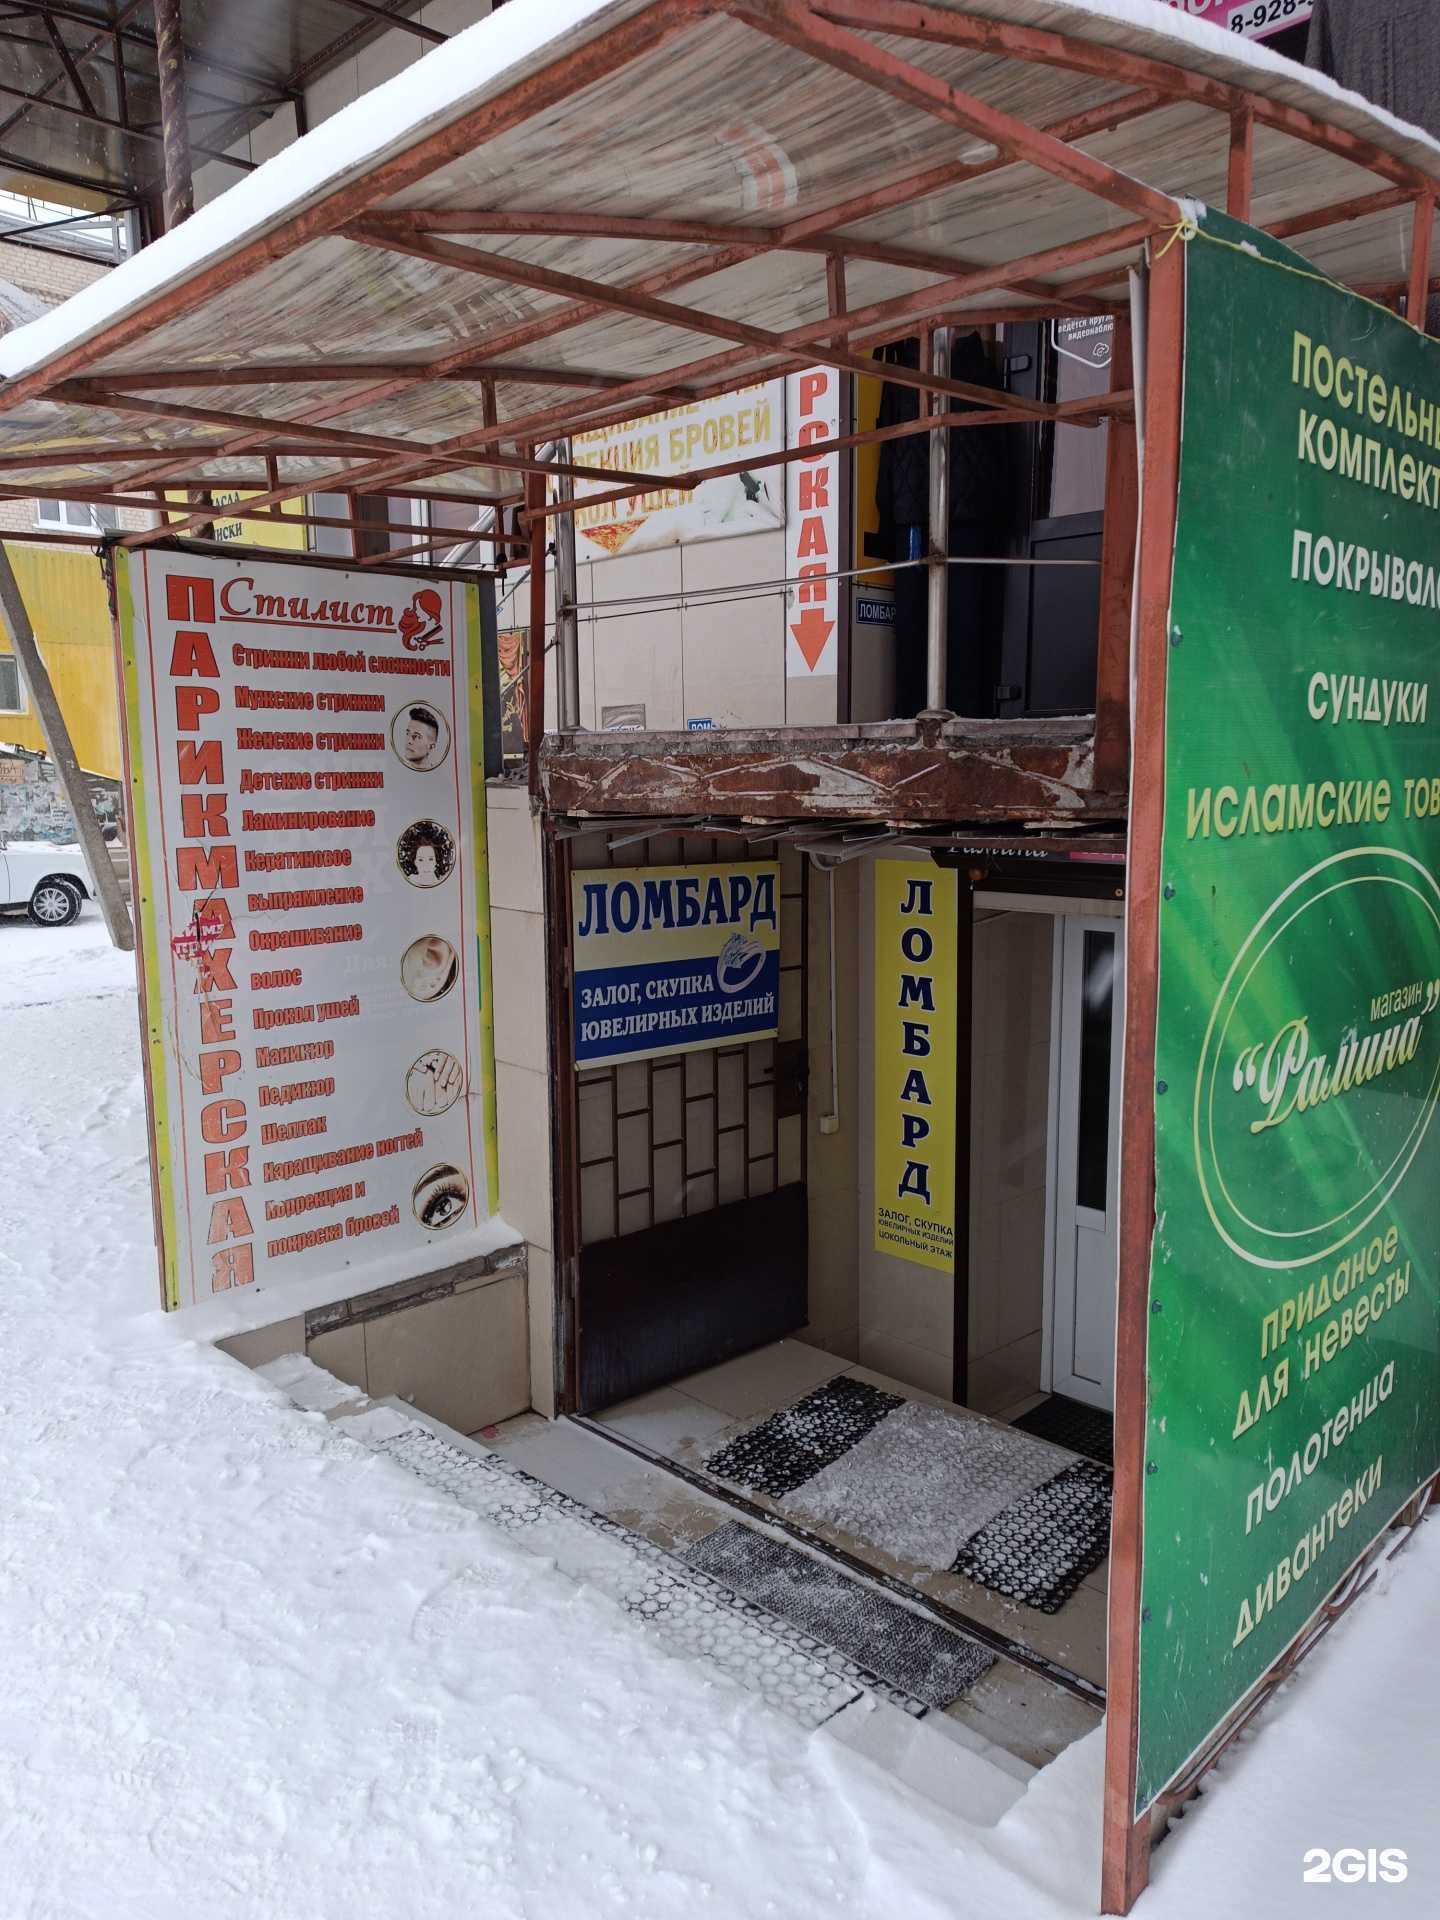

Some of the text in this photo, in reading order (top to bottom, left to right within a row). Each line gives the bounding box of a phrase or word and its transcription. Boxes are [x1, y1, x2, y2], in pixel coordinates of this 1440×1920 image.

[1231, 0, 1313, 33] 8-928-
[669, 399, 771, 464] БРОВЕЙ
[219, 577, 394, 626] Стилист
[232, 643, 451, 677] Стрижки любой сложности
[234, 685, 385, 713] Мужские стрижки
[236, 727, 385, 752] Женские стрижки
[240, 769, 384, 794] Детские стрижки
[242, 809, 375, 831] Ламинирование
[244, 848, 352, 872] Кератиновое
[579, 874, 776, 936] ЛОМБАРД
[165, 574, 255, 1294] ПАРИКМАХЕРСКАЯ
[249, 924, 362, 951] Окрашивание
[250, 968, 303, 991] волос
[581, 974, 714, 1009] ЗАЛОГ, СКУПКА
[252, 995, 360, 1030] Прокол ушей
[581, 992, 775, 1042] ЮВЕЛИРНЫХ ИЗДЕЛИЙ
[1371, 981, 1423, 1022] магазин
[255, 1039, 335, 1068] Маникюр
[898, 879, 935, 1206] ЛОМБАРД
[258, 1077, 336, 1107] Педикюр
[261, 1115, 327, 1145] Шеллак
[263, 1127, 424, 1183] Наращивание ногтей
[265, 1181, 366, 1221] Коррекция и
[267, 1203, 400, 1258] покраска бровей
[879, 1219, 920, 1236] ЮВЕЛИРНЫХ
[914, 1218, 953, 1236] СКУПКА
[879, 1230, 953, 1258] ЦОКОЛЬНЫЙ ЭТАЖ
